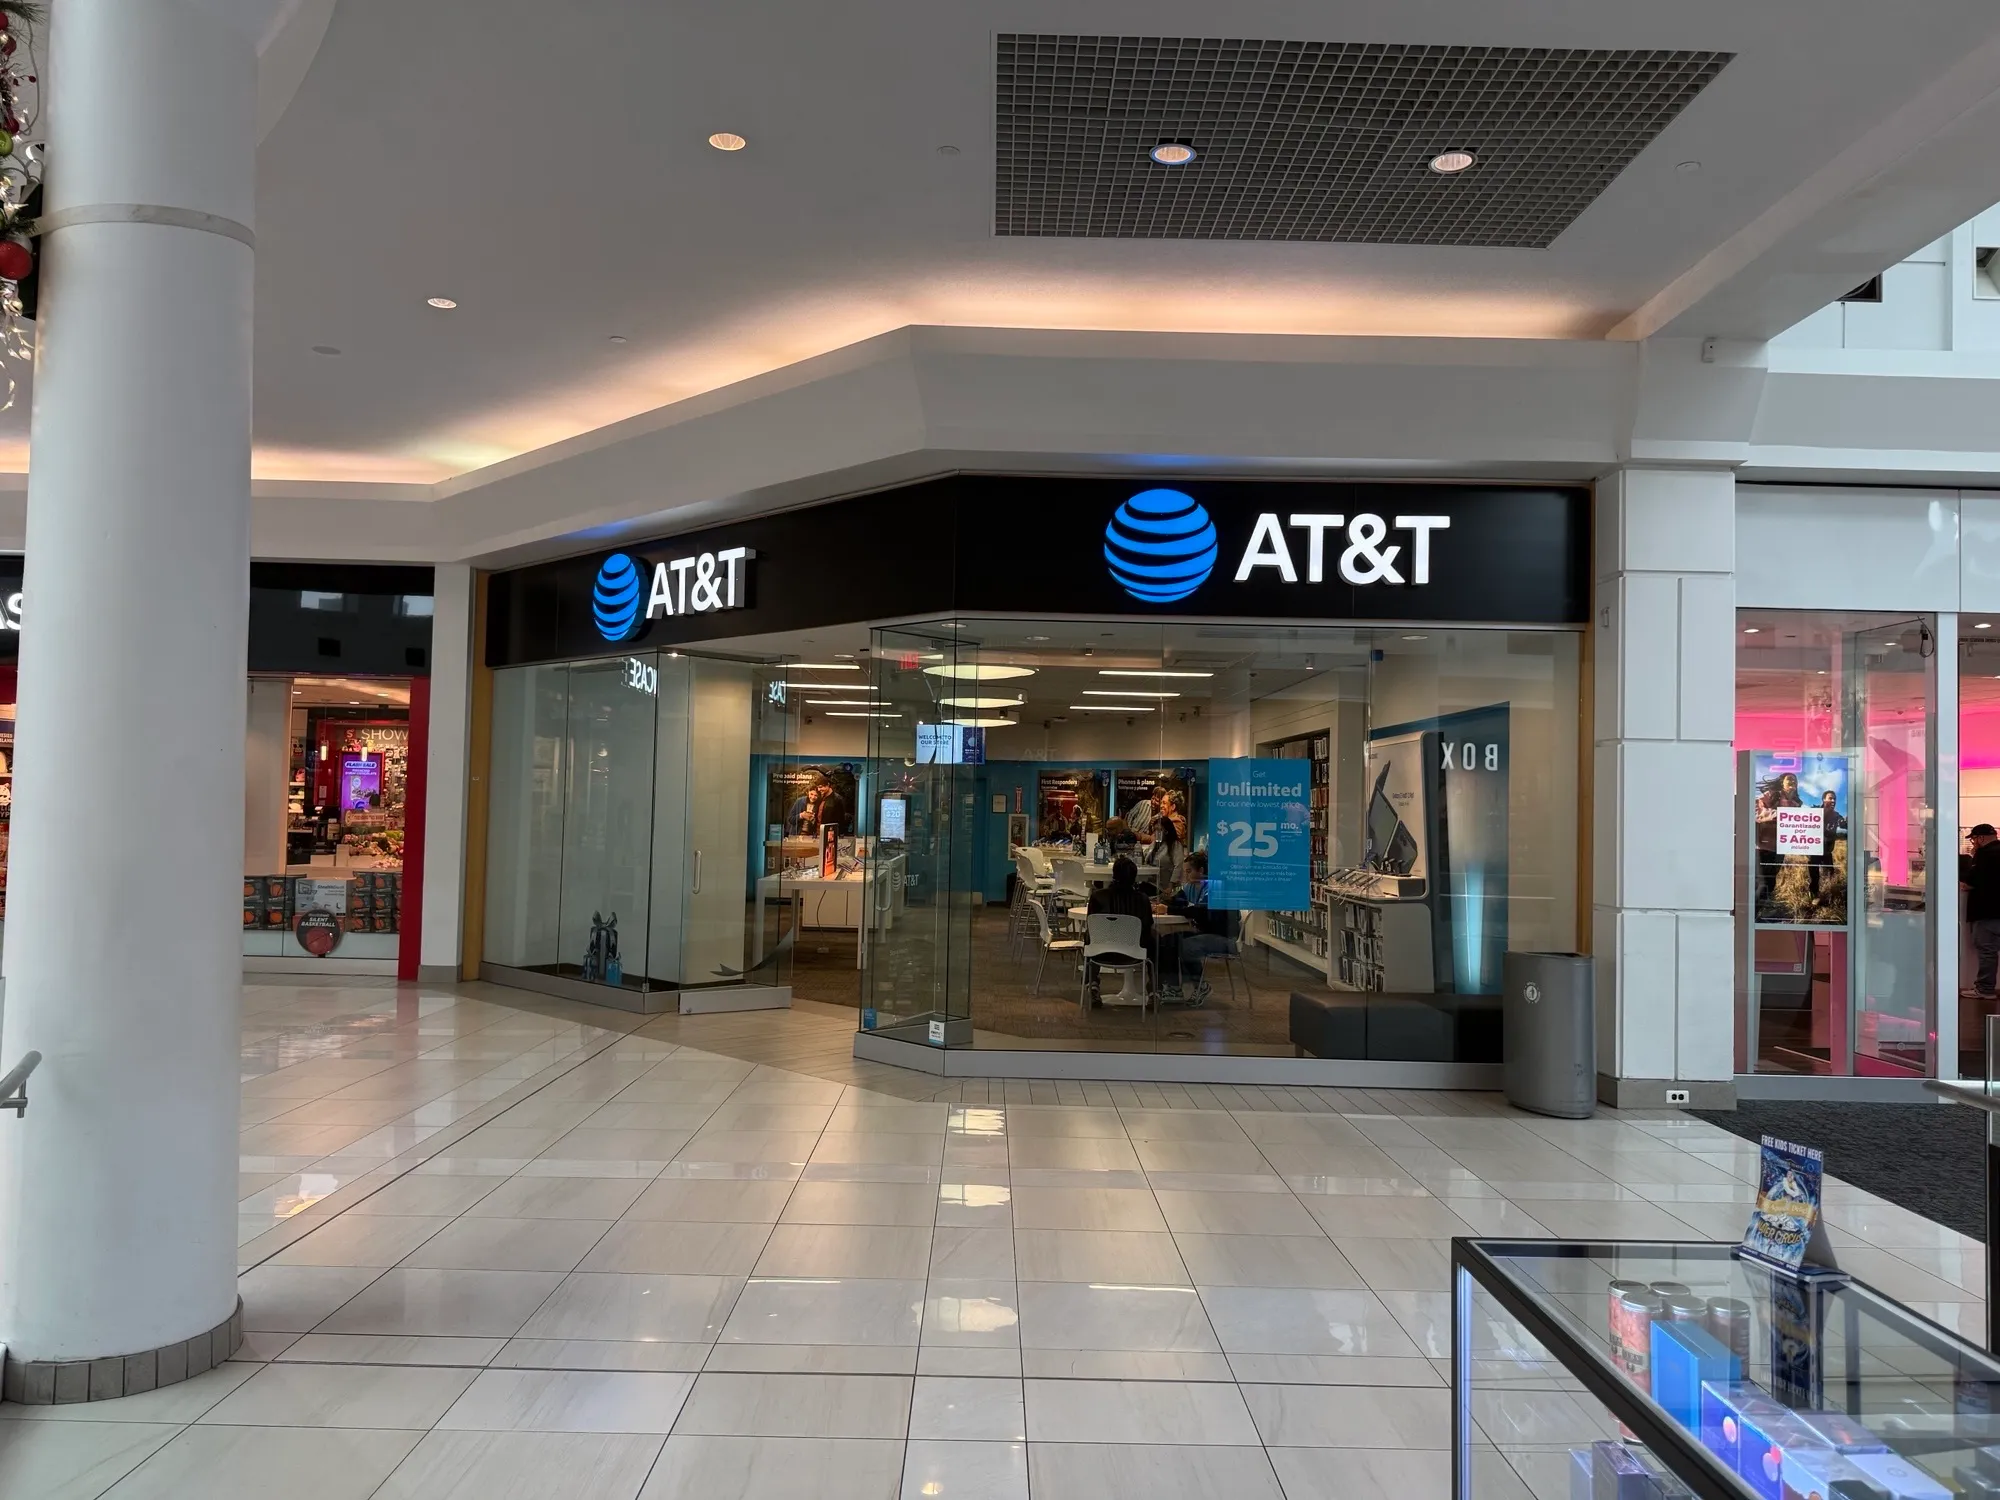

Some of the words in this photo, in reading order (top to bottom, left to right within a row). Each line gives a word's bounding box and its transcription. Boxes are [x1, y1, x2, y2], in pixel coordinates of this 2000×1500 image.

[1234, 513, 1450, 585] AT&T
[646, 547, 751, 619] AT&T
[361, 729, 408, 741] SHOW
[1252, 770, 1266, 778] Get
[1052, 778, 1078, 788] Responders
[1141, 779, 1155, 787] plans
[1217, 782, 1302, 797] Unlimited
[1217, 800, 1227, 808] for
[1257, 800, 1280, 808] lowest
[1281, 801, 1301, 810] price
[1779, 812, 1821, 823] Precio
[1217, 820, 1279, 858] $25
[1280, 822, 1300, 830] mo.
[1780, 834, 1788, 844] 5
[1789, 834, 1821, 844] Años
[902, 874, 920, 887] AT&T
[1761, 1134, 1774, 1147] FREE
[1774, 1138, 1788, 1152] KIDS
[1788, 1142, 1807, 1157] TICKET
[1807, 1147, 1822, 1162] HERE
